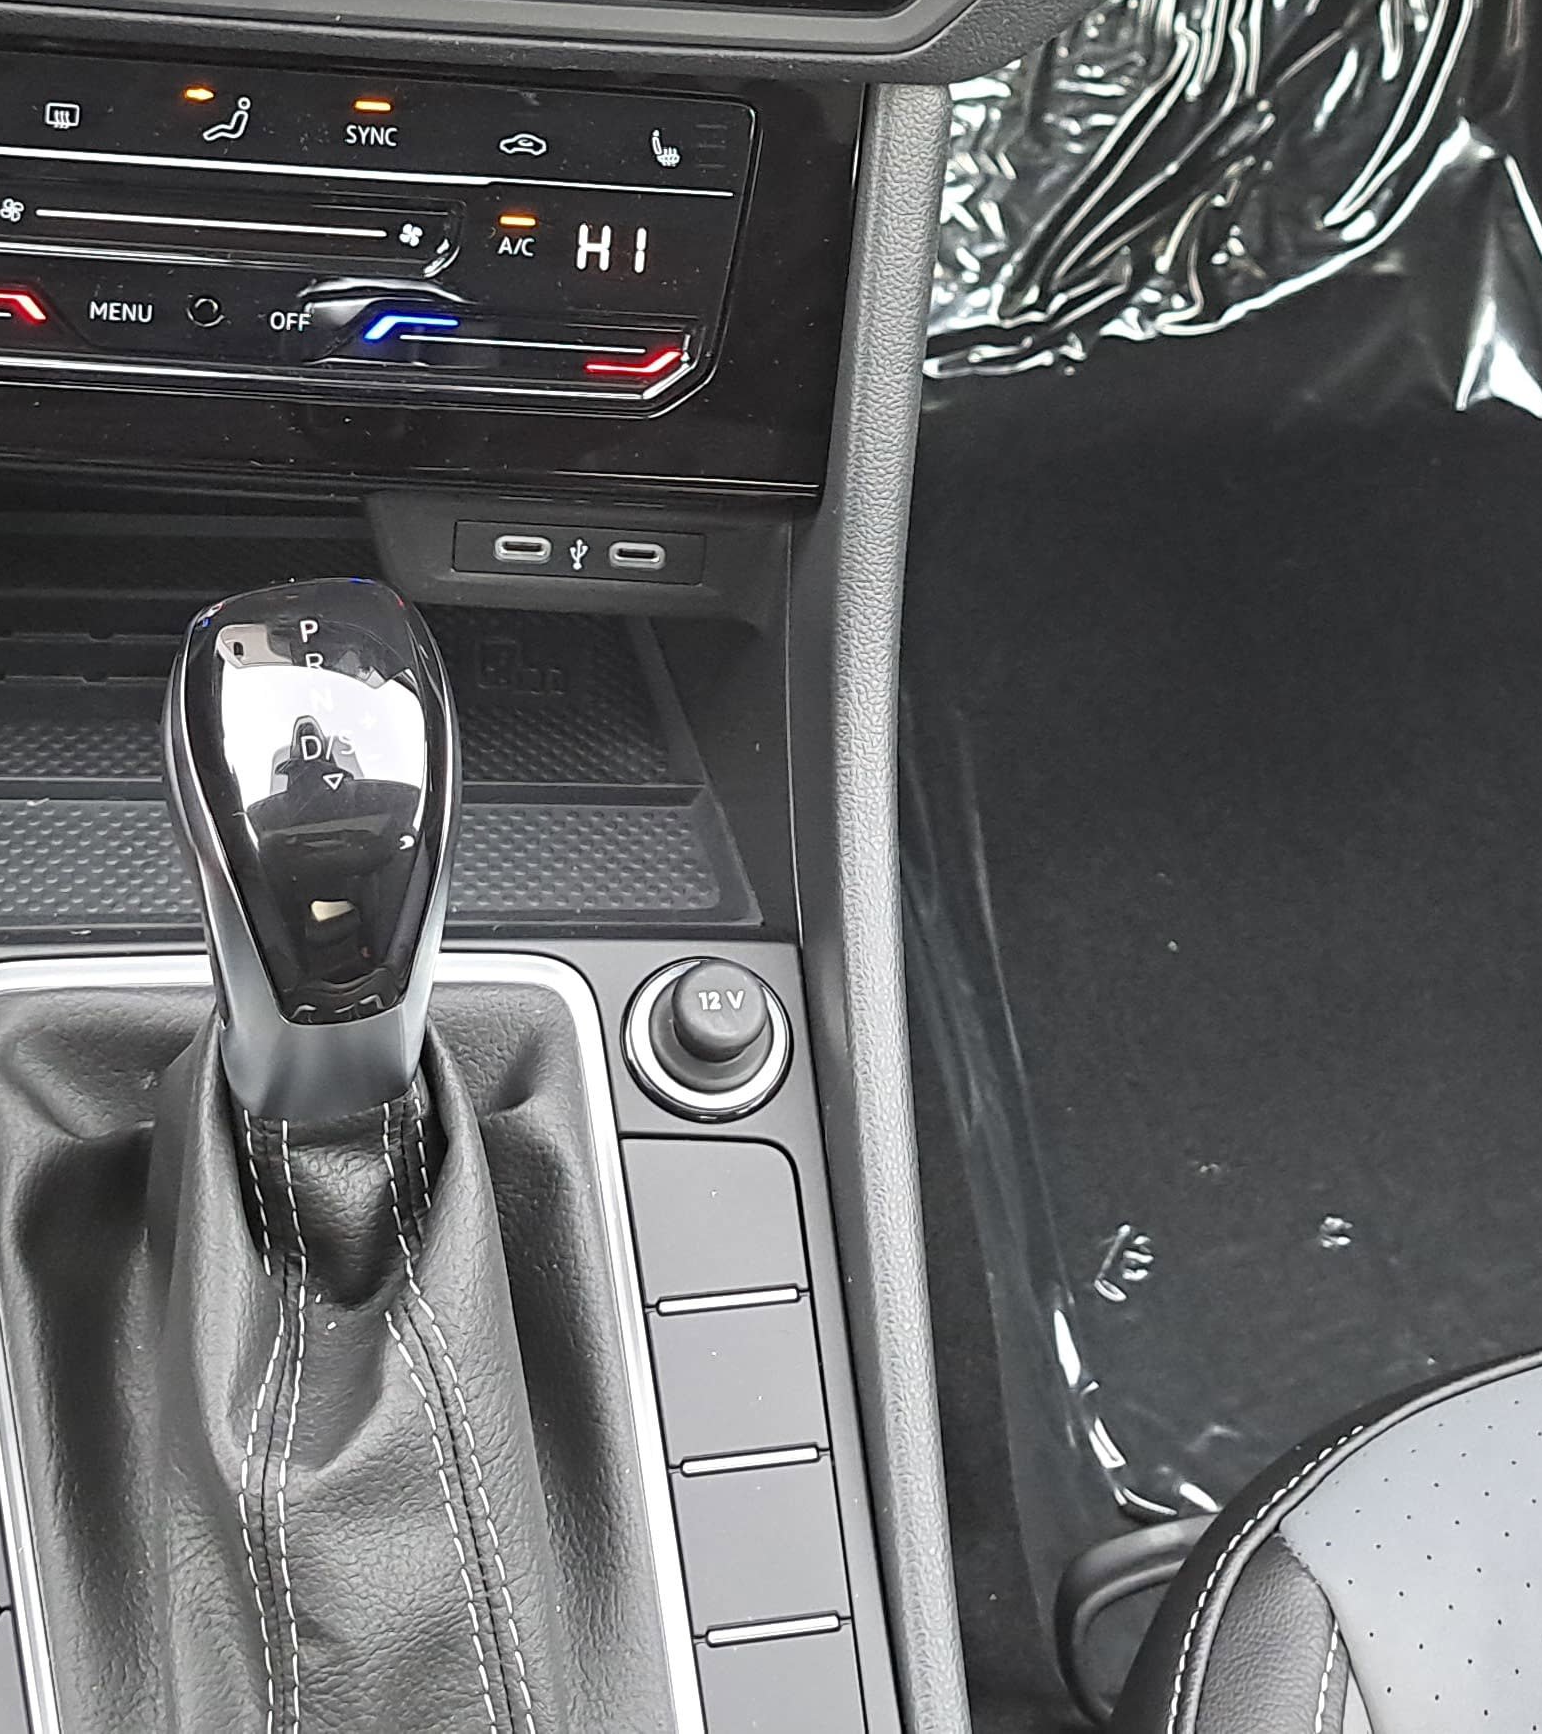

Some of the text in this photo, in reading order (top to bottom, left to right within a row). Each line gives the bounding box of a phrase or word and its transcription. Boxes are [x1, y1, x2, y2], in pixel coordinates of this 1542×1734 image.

[346, 124, 399, 147] SYNC
[498, 237, 536, 258] A/C
[89, 300, 154, 324] MENU
[270, 311, 312, 332] OFF
[299, 618, 319, 643] P
[300, 733, 356, 762] D/S
[698, 990, 745, 1011] 12 V
